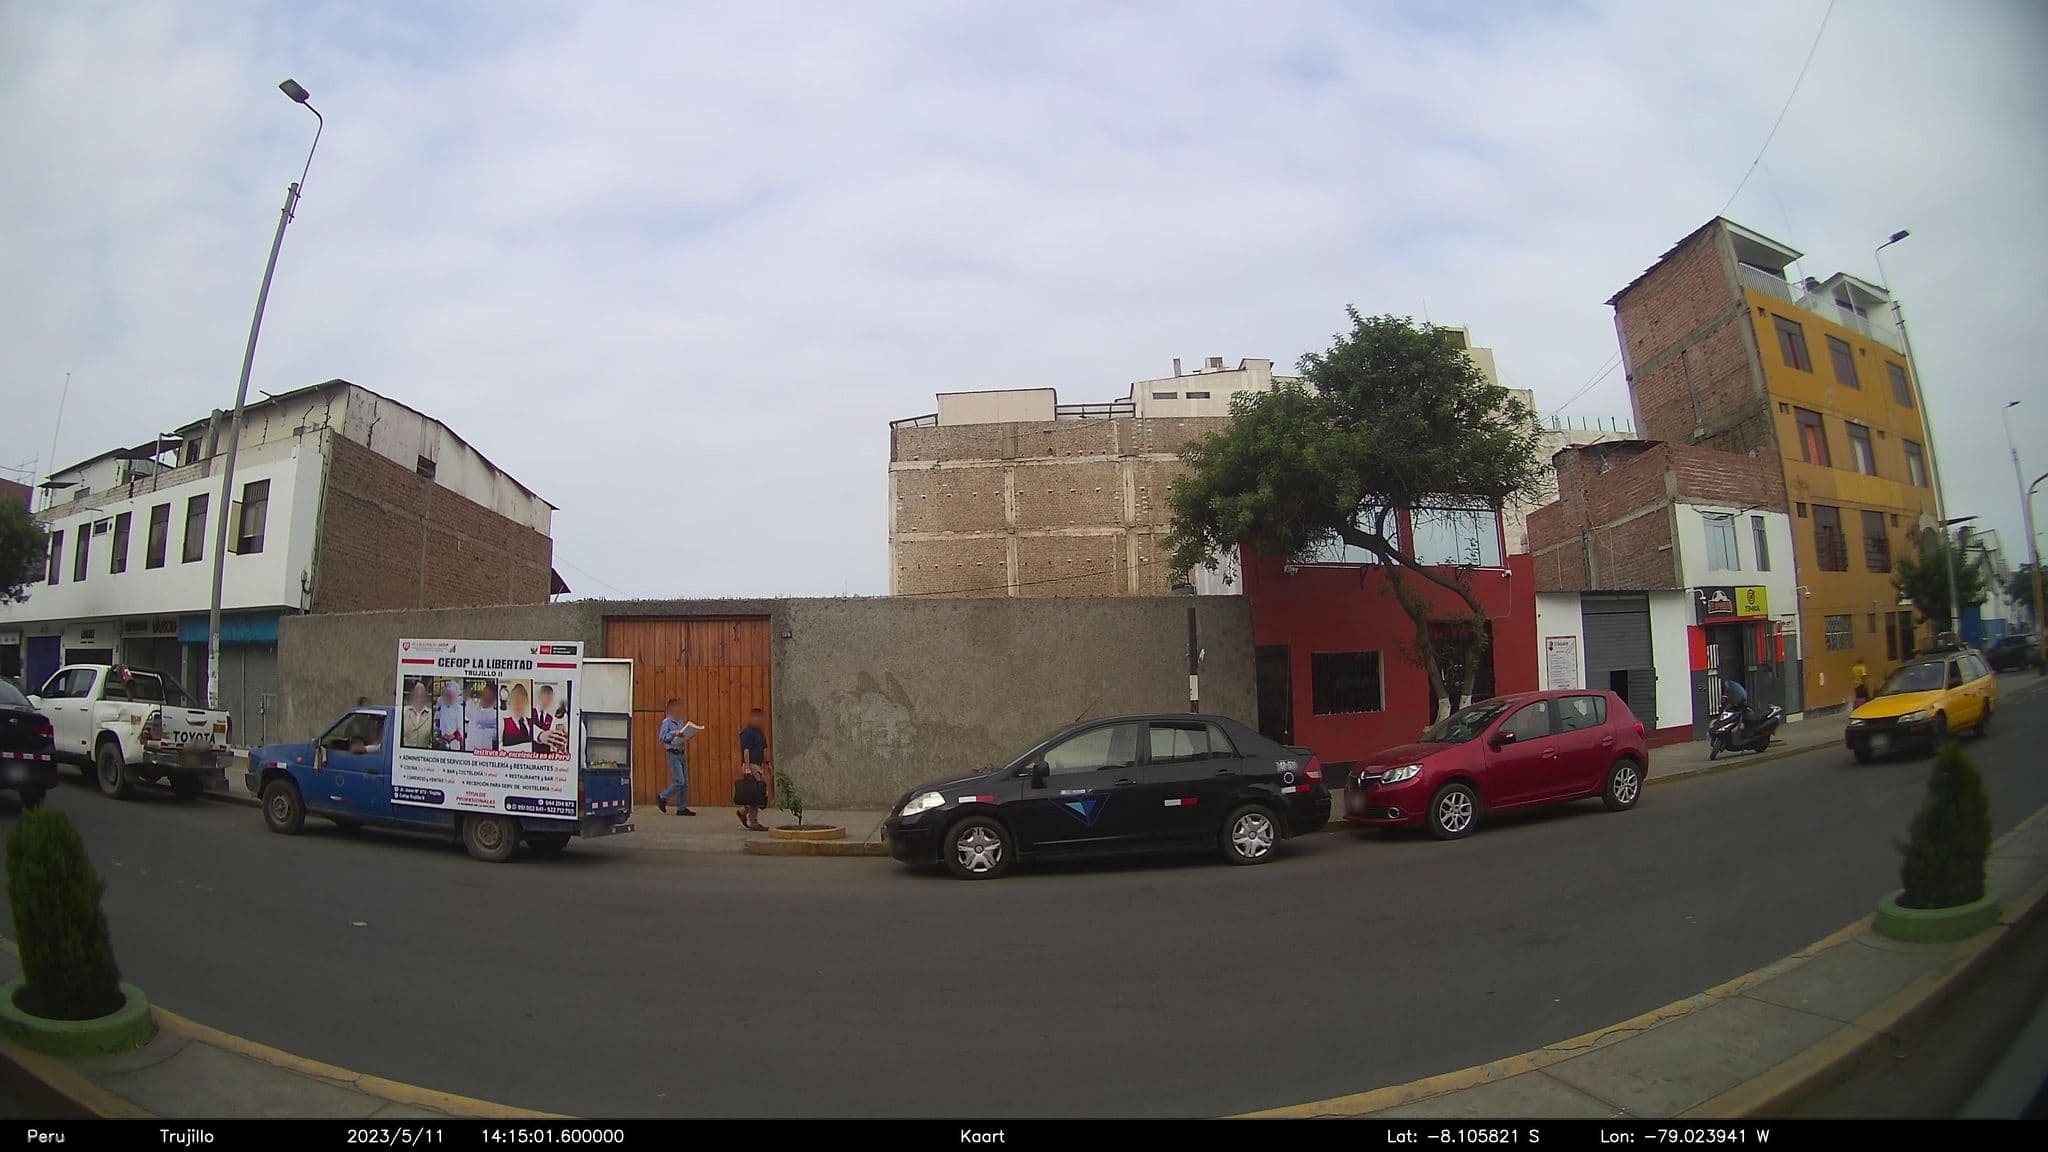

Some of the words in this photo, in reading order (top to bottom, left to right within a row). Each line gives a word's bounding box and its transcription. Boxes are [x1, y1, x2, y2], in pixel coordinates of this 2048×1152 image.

[438, 657, 470, 668] CEFOP
[472, 658, 484, 669] LA
[486, 658, 533, 670] LIBERTAD
[464, 669, 496, 677] TRUJILLO
[173, 731, 215, 745] TOYOTA
